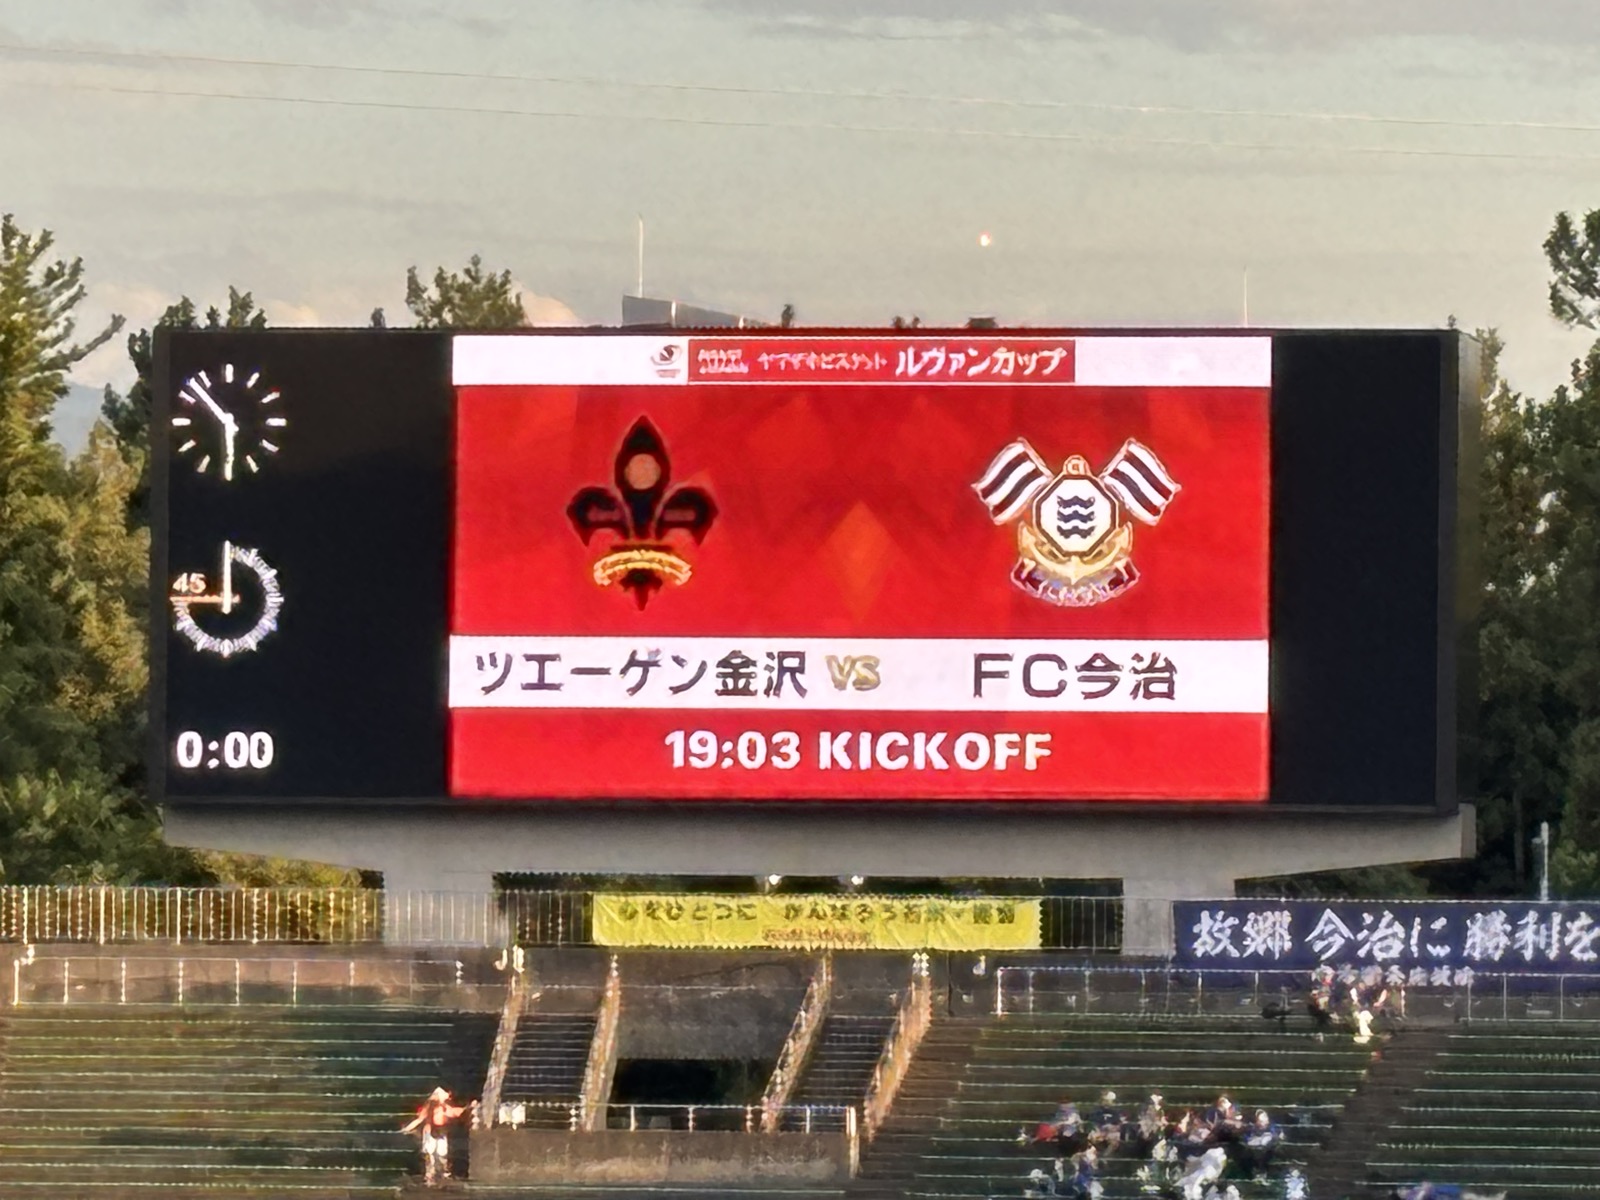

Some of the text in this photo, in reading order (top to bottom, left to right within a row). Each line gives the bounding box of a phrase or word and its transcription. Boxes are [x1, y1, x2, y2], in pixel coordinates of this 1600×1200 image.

[895, 345, 1068, 377] ルヴァンカップ
[172, 572, 207, 594] 45
[475, 649, 1177, 700] ツエーゲン金沢 VS FC今治
[176, 730, 275, 769] 0:00
[664, 729, 1053, 771] 19:03 KICKOFF
[1192, 908, 1293, 960] 故郷
[1304, 907, 1452, 962] 今治に
